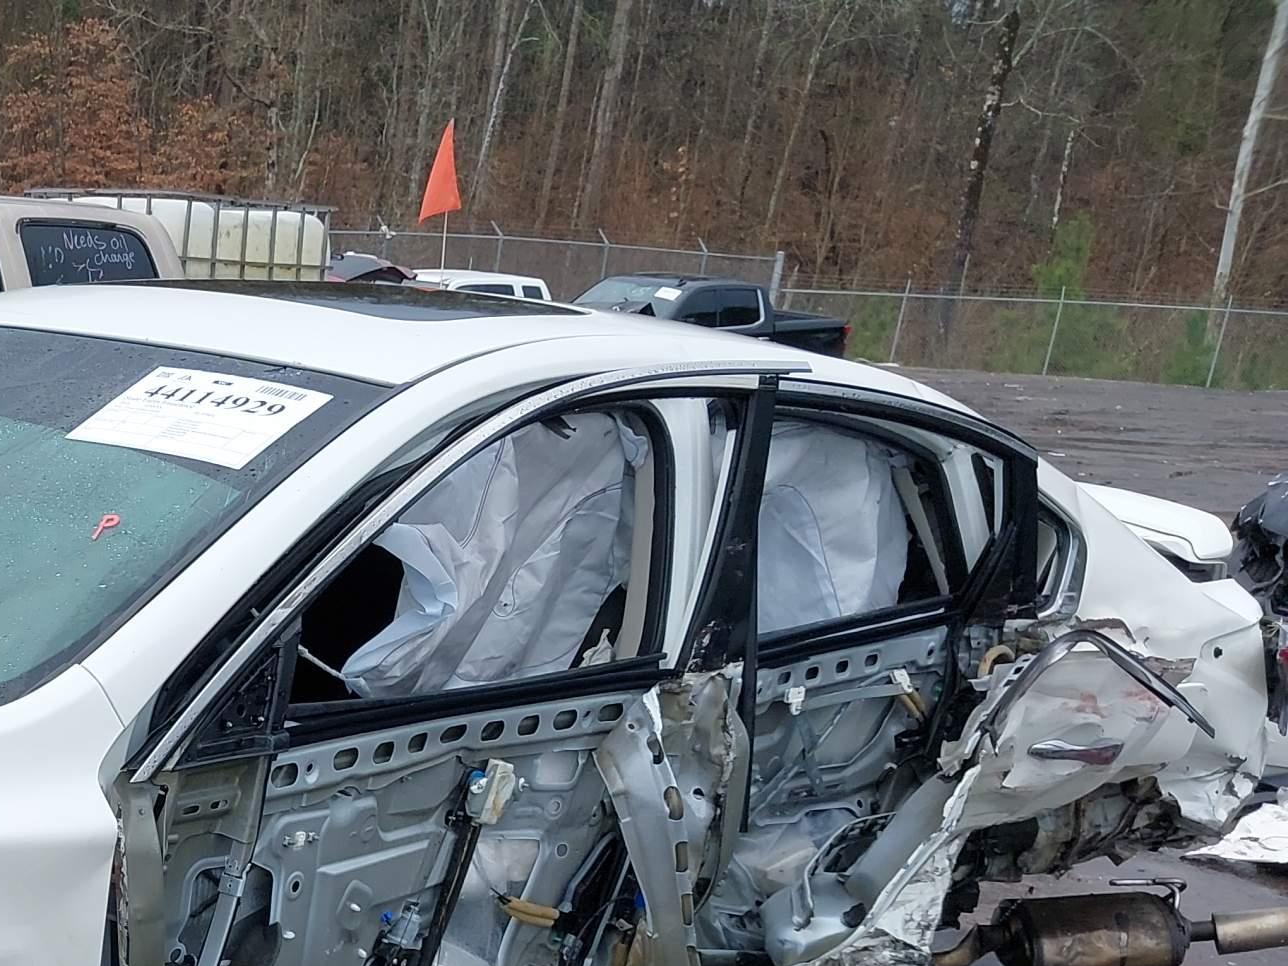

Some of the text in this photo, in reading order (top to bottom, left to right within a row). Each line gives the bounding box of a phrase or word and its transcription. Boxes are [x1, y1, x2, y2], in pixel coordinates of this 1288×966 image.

[63, 229, 107, 250] Needs
[94, 250, 136, 269] change
[144, 384, 286, 417] 44114929
[91, 513, 121, 541] P
